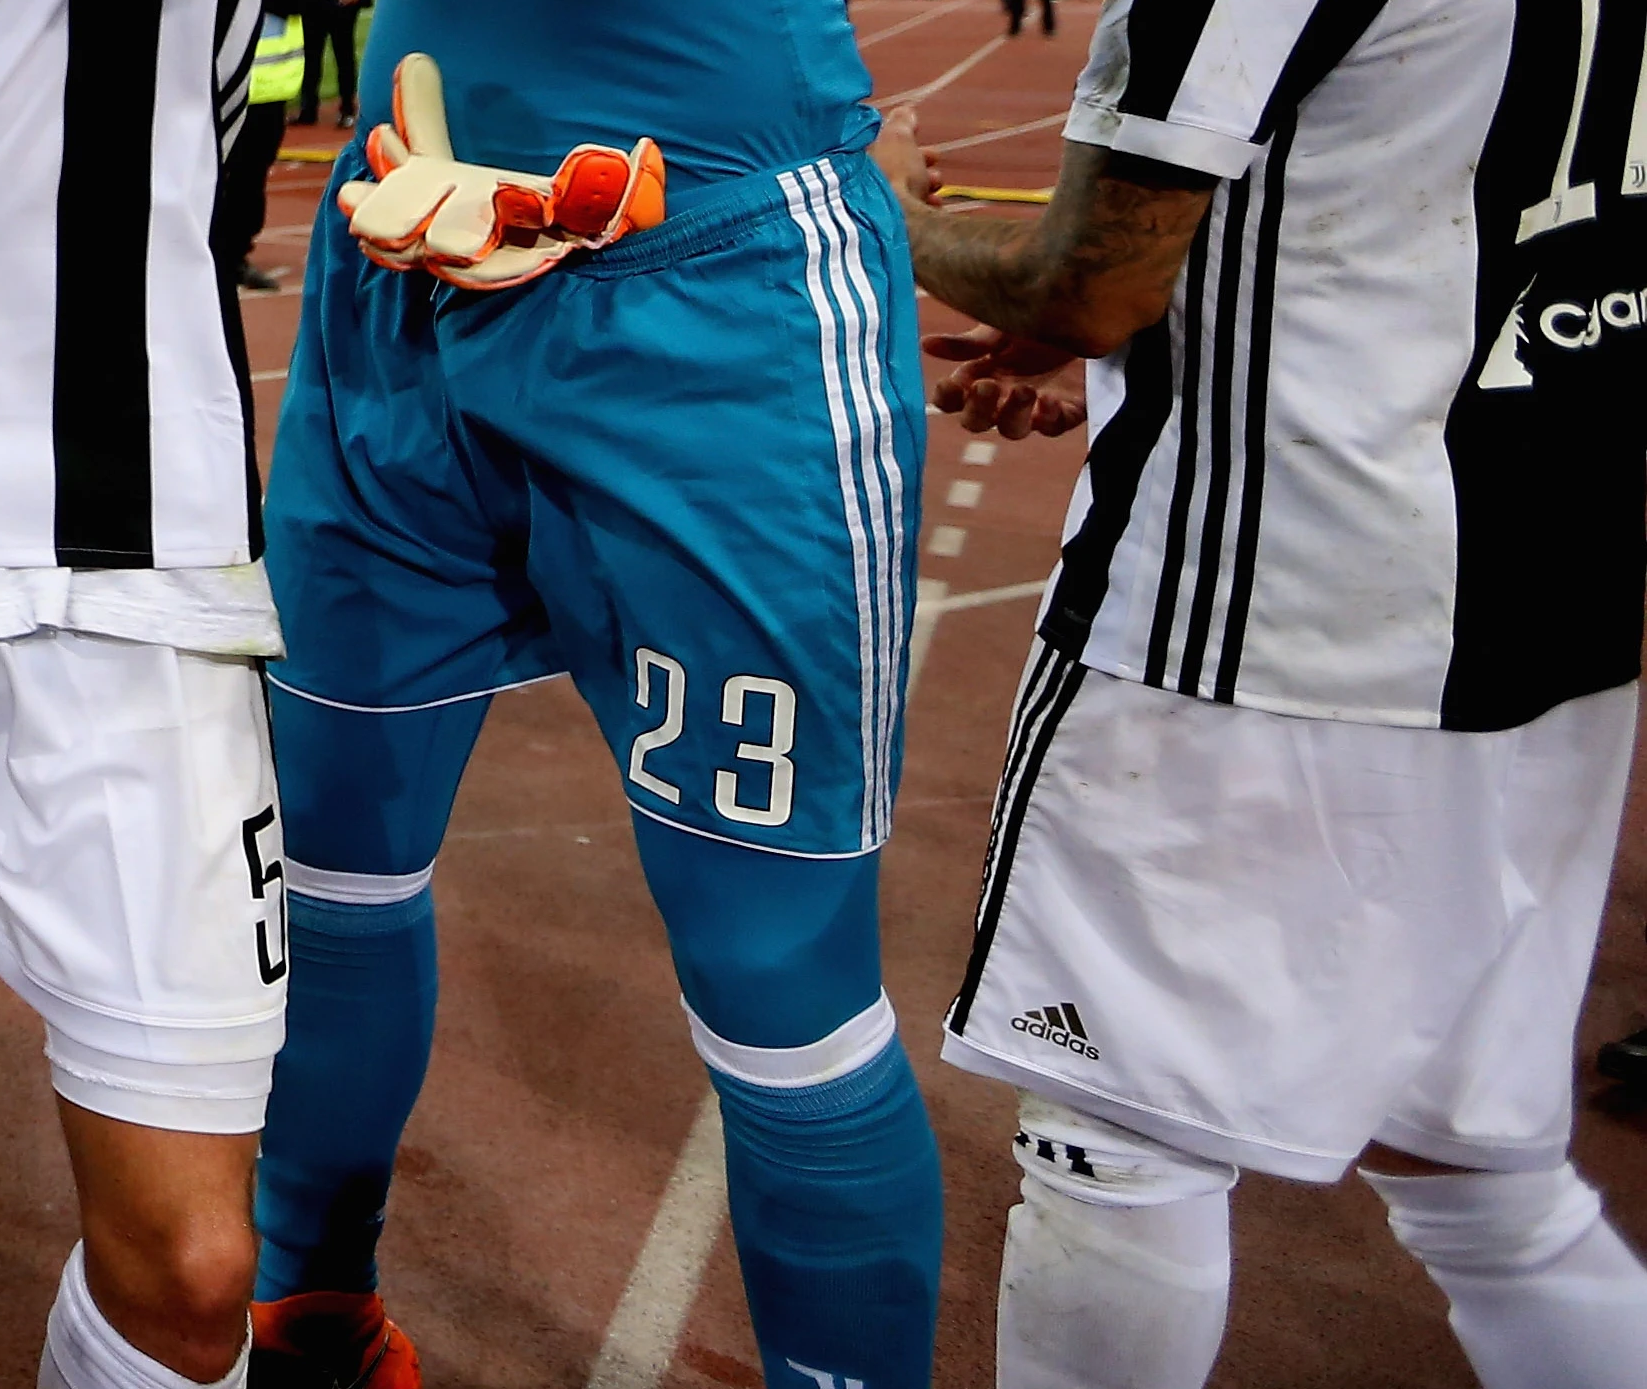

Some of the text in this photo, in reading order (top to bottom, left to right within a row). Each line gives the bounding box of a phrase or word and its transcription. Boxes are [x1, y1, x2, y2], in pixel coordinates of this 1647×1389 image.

[627, 646, 797, 828] 23
[242, 804, 287, 987] 5
[1010, 1017, 1100, 1061] adidas
